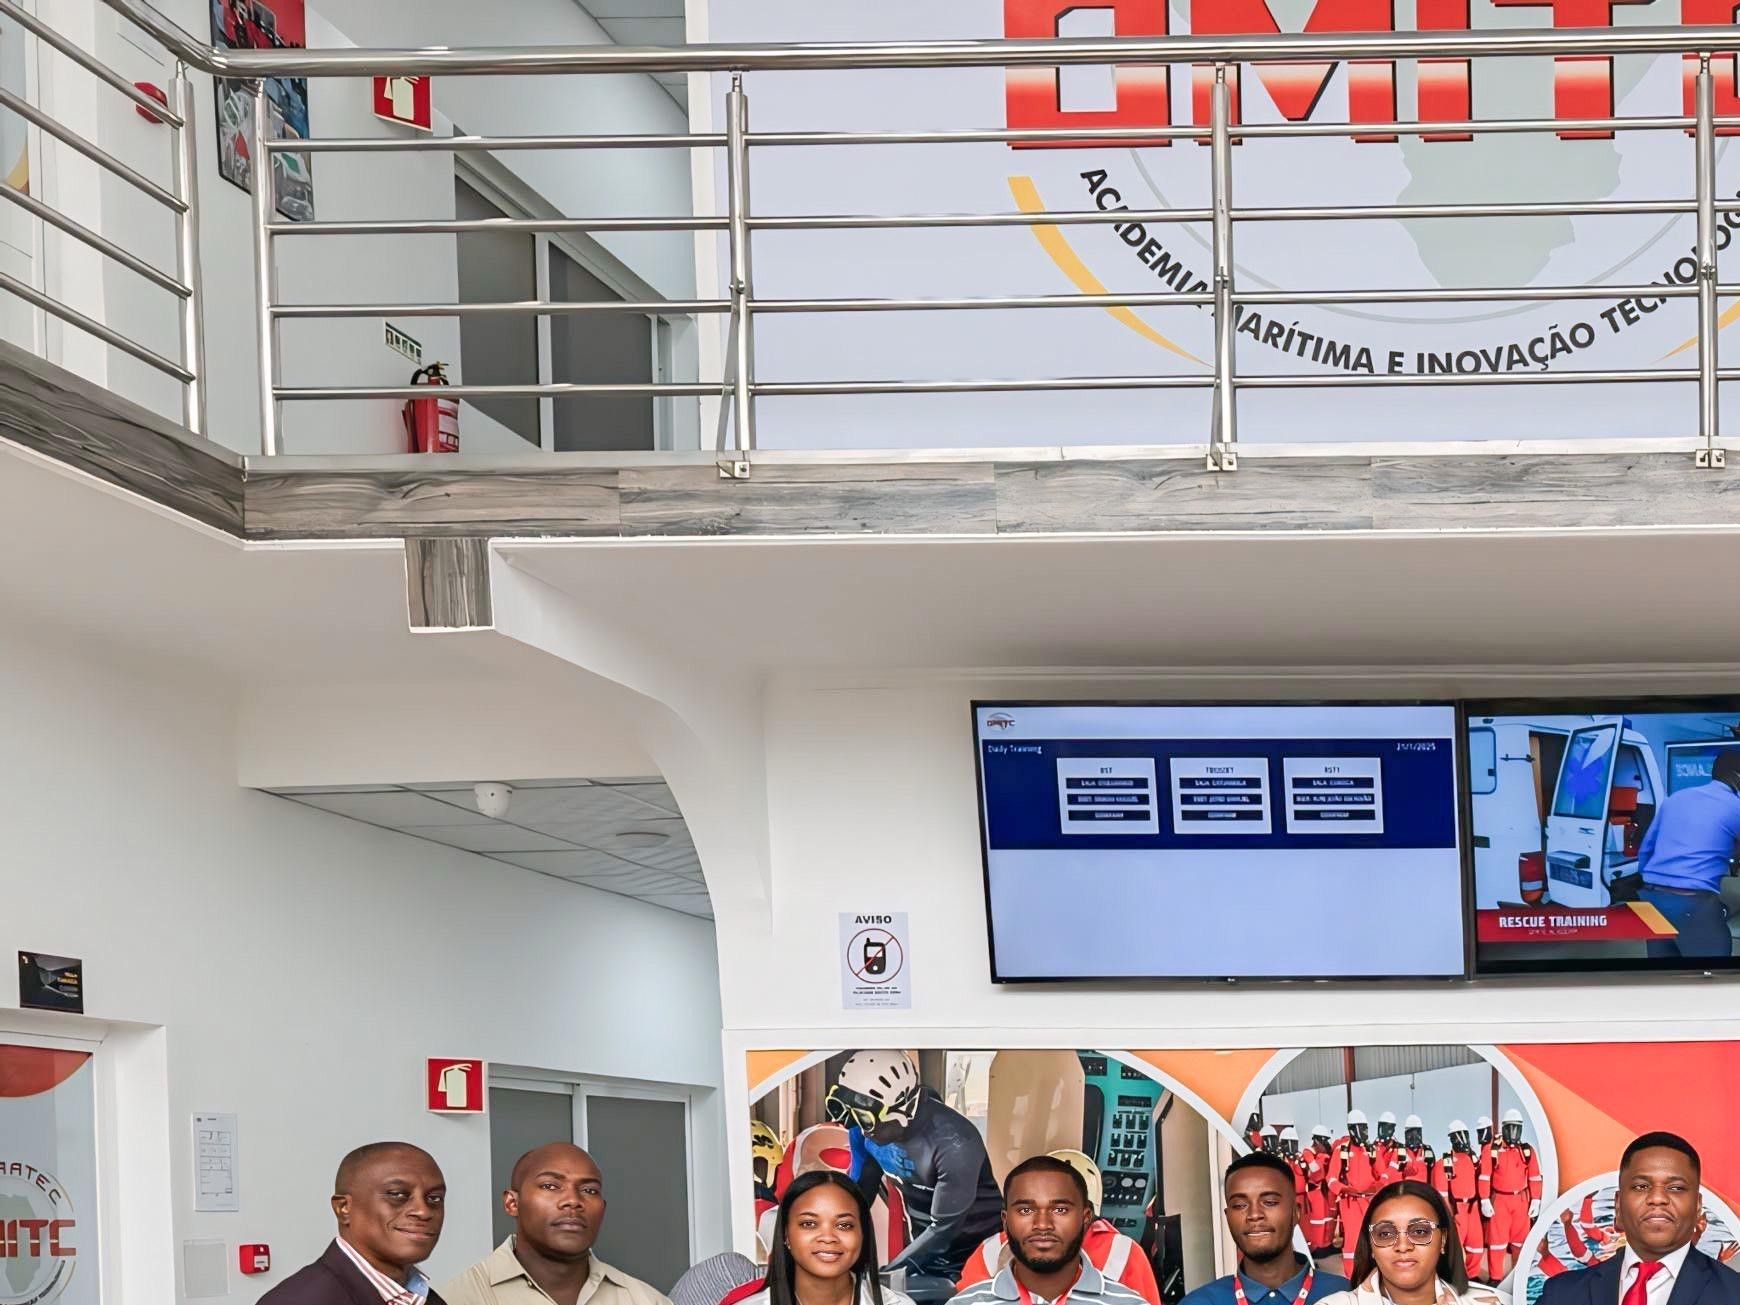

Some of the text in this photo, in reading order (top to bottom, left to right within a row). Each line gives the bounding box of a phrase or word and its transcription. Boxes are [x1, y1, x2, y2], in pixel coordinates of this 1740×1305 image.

[1387, 351, 1405, 375] E
[1416, 322, 1596, 375] INOVAÇÃO
[855, 915, 892, 924] AVISO
[1499, 915, 1608, 928] RESCUE TRAINING
